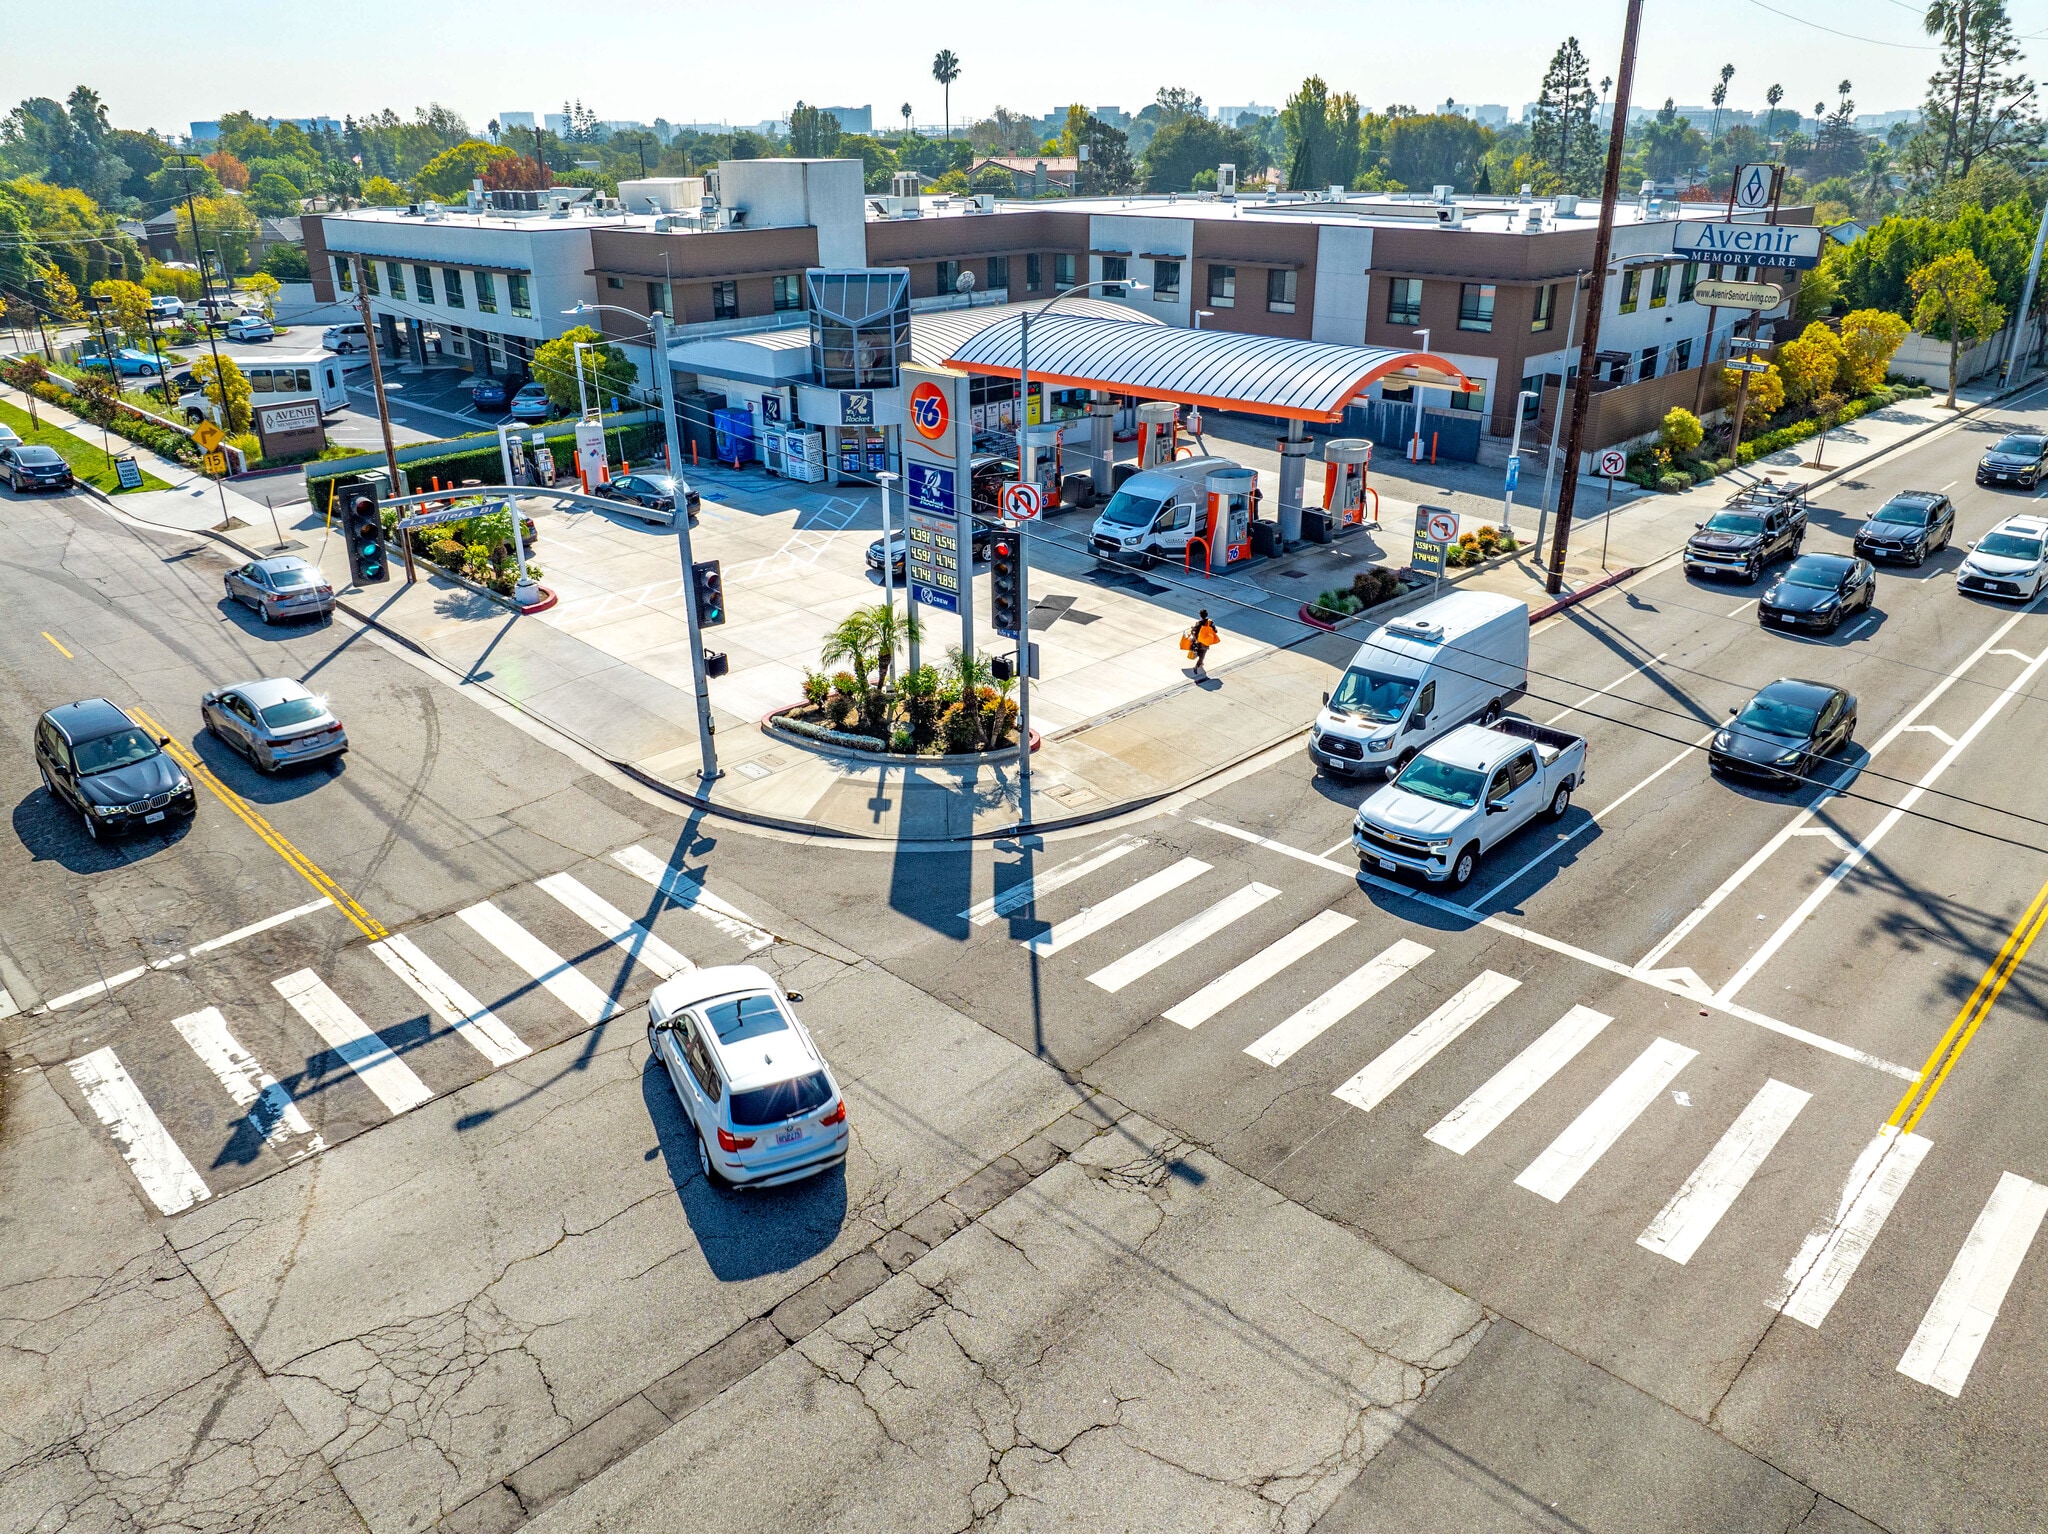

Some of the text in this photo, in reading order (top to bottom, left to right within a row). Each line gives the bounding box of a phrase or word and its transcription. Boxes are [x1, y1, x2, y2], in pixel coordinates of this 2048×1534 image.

[1696, 224, 1798, 252] Avenir
[1691, 251, 1797, 268] MEMORY CARE
[1695, 288, 1778, 305] www.AvenirSeniorLiving.com
[275, 407, 315, 421] AVENIR
[844, 415, 870, 423] Rocket
[914, 396, 942, 430] 76
[207, 455, 221, 467] 15
[920, 495, 944, 510] Rocket
[409, 505, 493, 526] La Tijera Bl
[1227, 545, 1239, 563] 76
[933, 596, 949, 605] CREW
